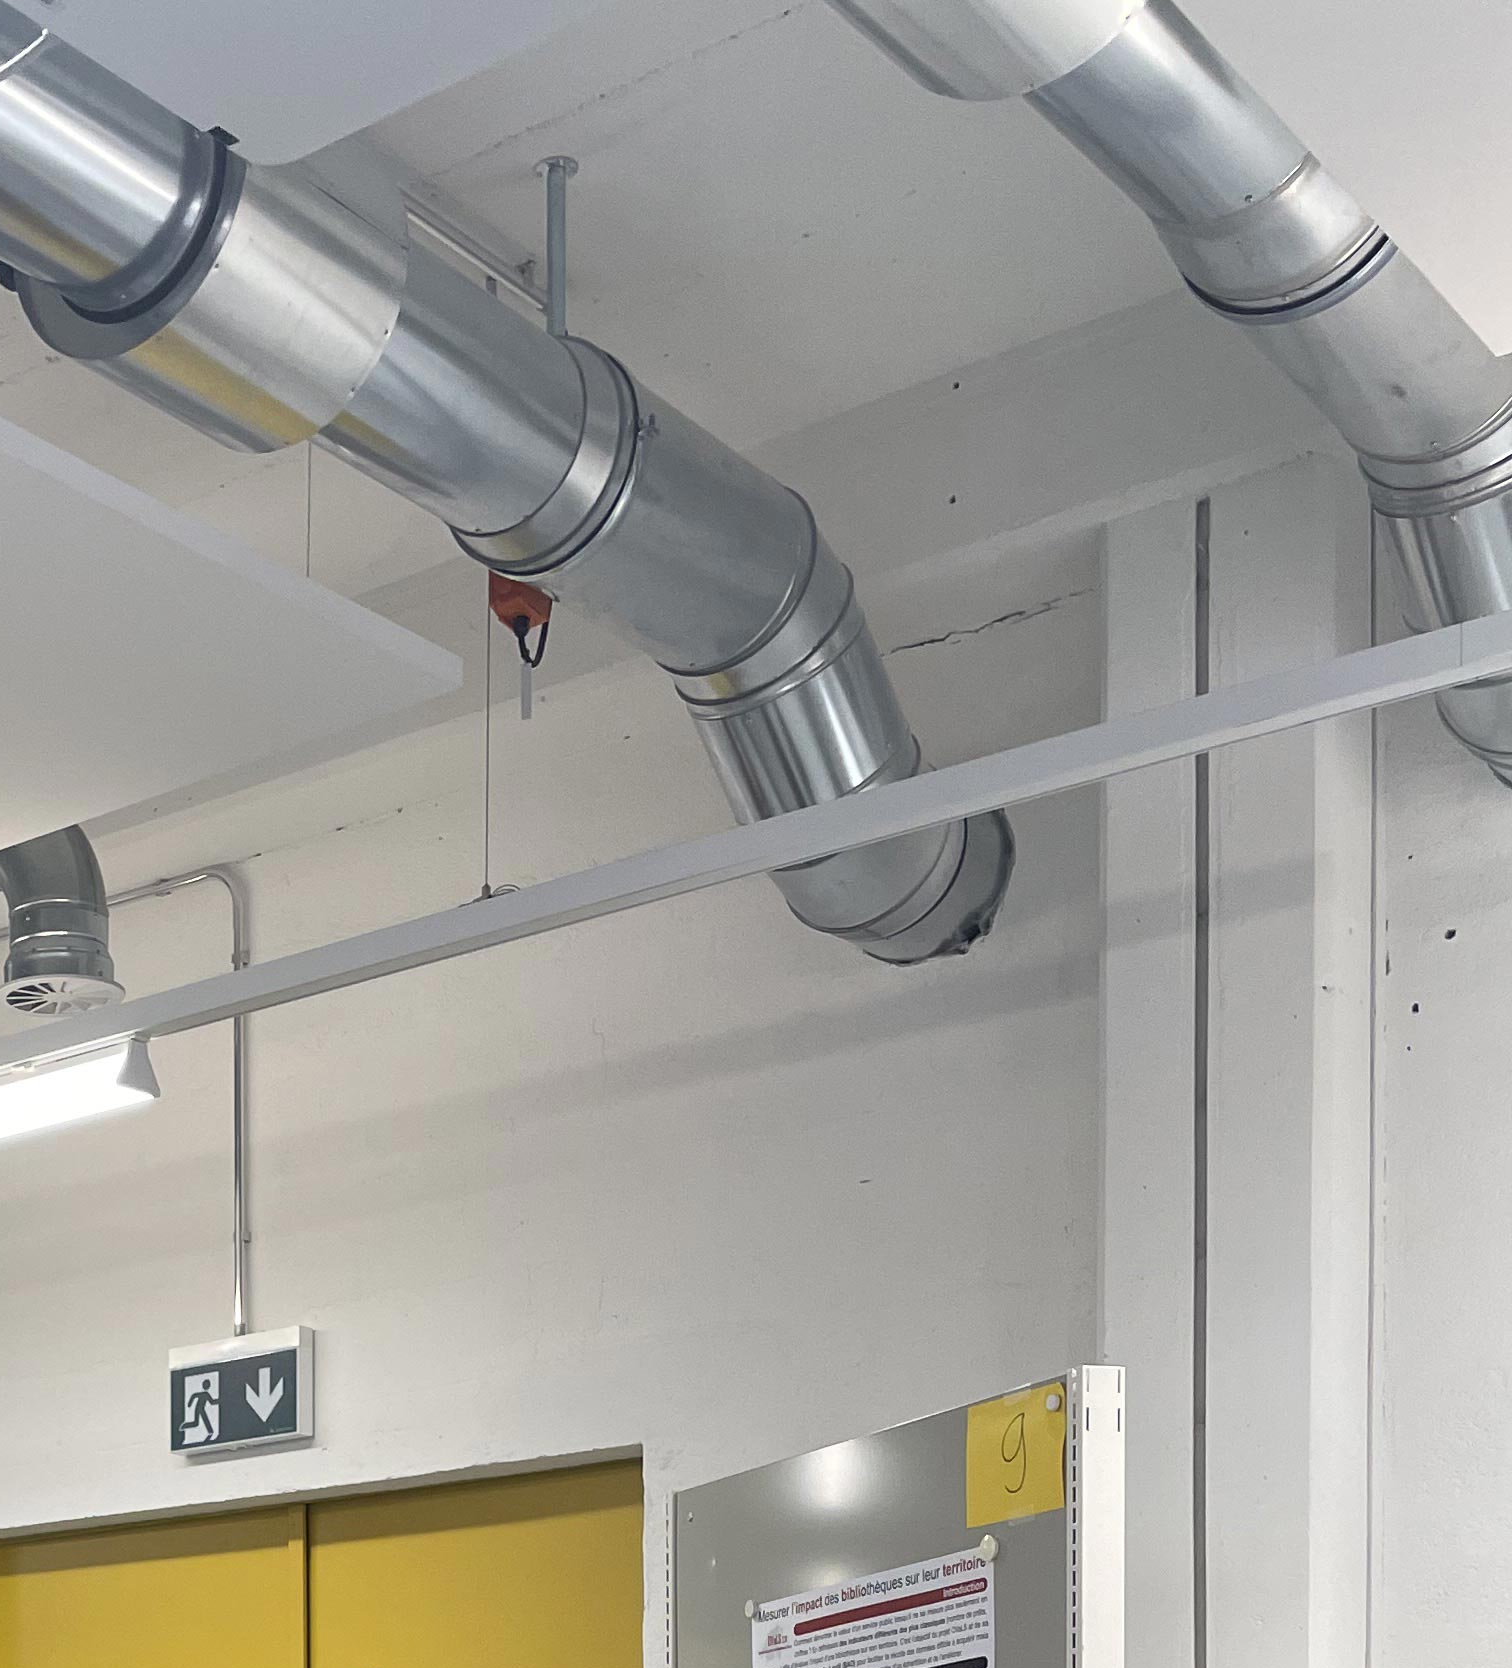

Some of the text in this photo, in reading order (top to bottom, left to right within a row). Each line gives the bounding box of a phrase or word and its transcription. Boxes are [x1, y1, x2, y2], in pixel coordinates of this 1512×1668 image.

[1001, 1412, 1027, 1494] 9
[758, 1555, 986, 1623] Mesurer l'impact des bibliothèques sur leur territoire
